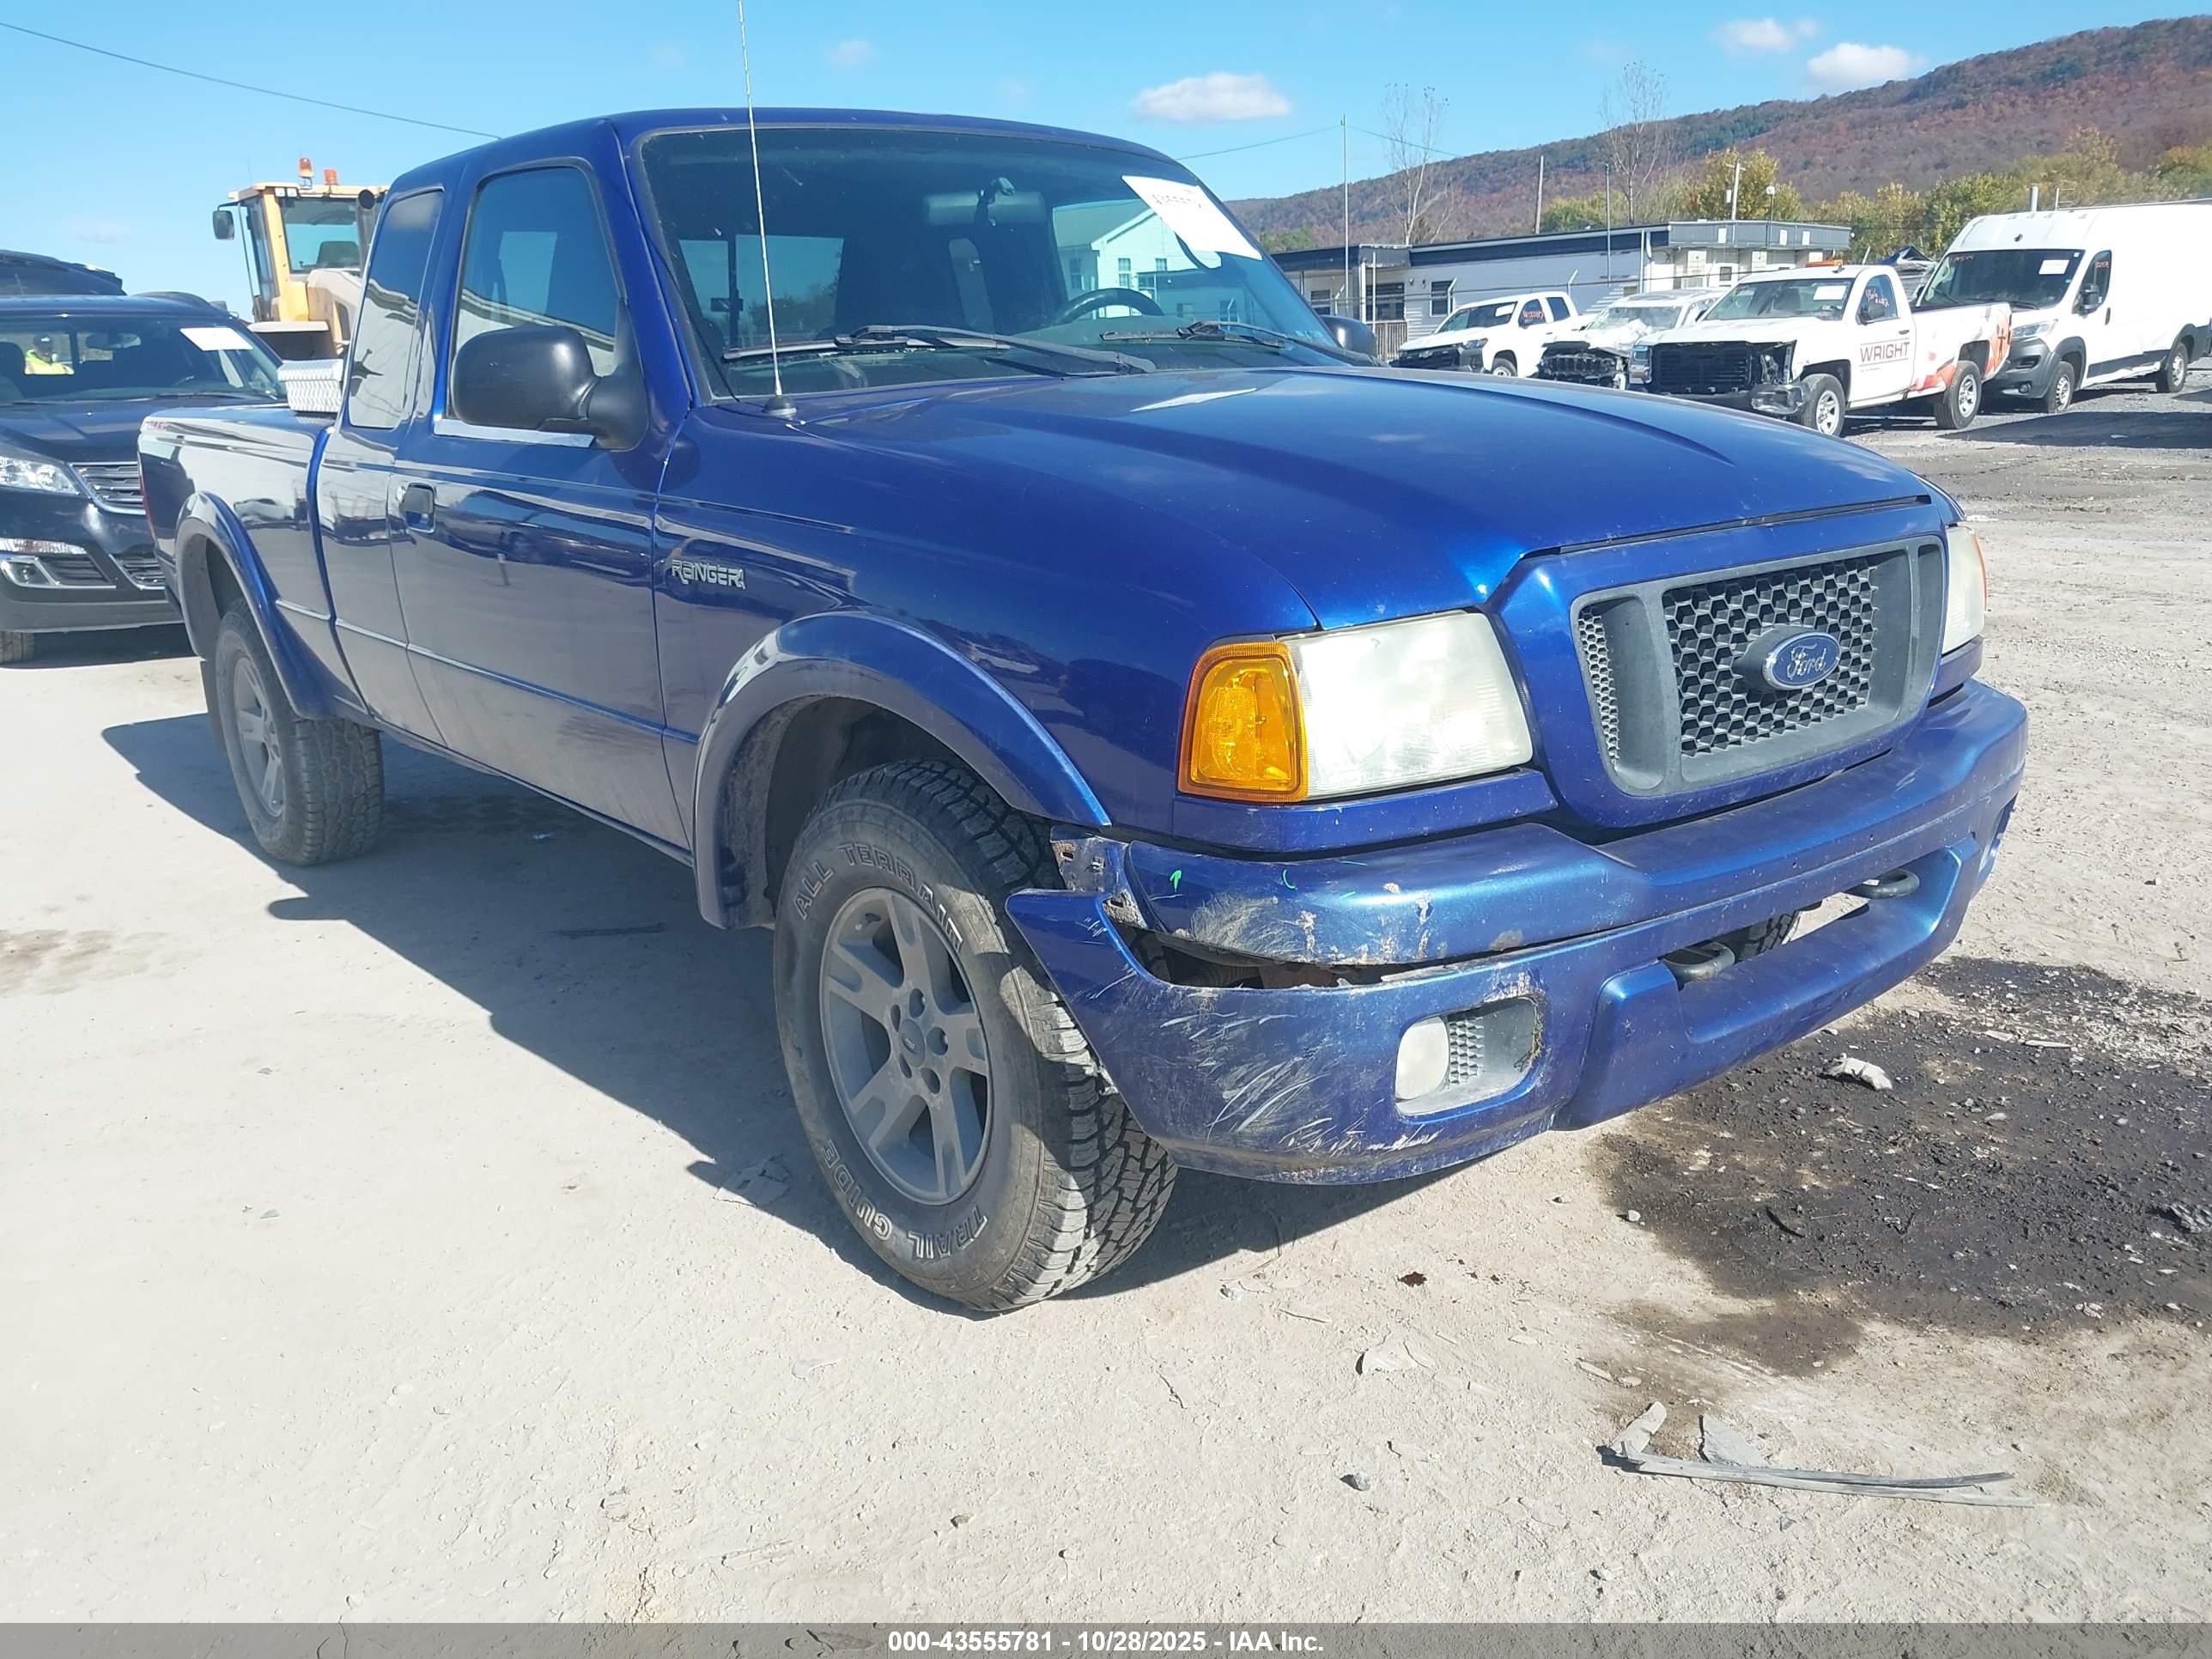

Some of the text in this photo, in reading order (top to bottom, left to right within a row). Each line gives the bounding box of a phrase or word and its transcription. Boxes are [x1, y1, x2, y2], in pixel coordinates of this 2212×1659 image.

[1860, 342, 1910, 363] WRIGHT
[672, 559, 746, 590] RANGER
[1786, 643, 1827, 680] Ford
[793, 843, 963, 953] ALL TERRAIN
[821, 1139, 988, 1259] TRAIL GUIDE
